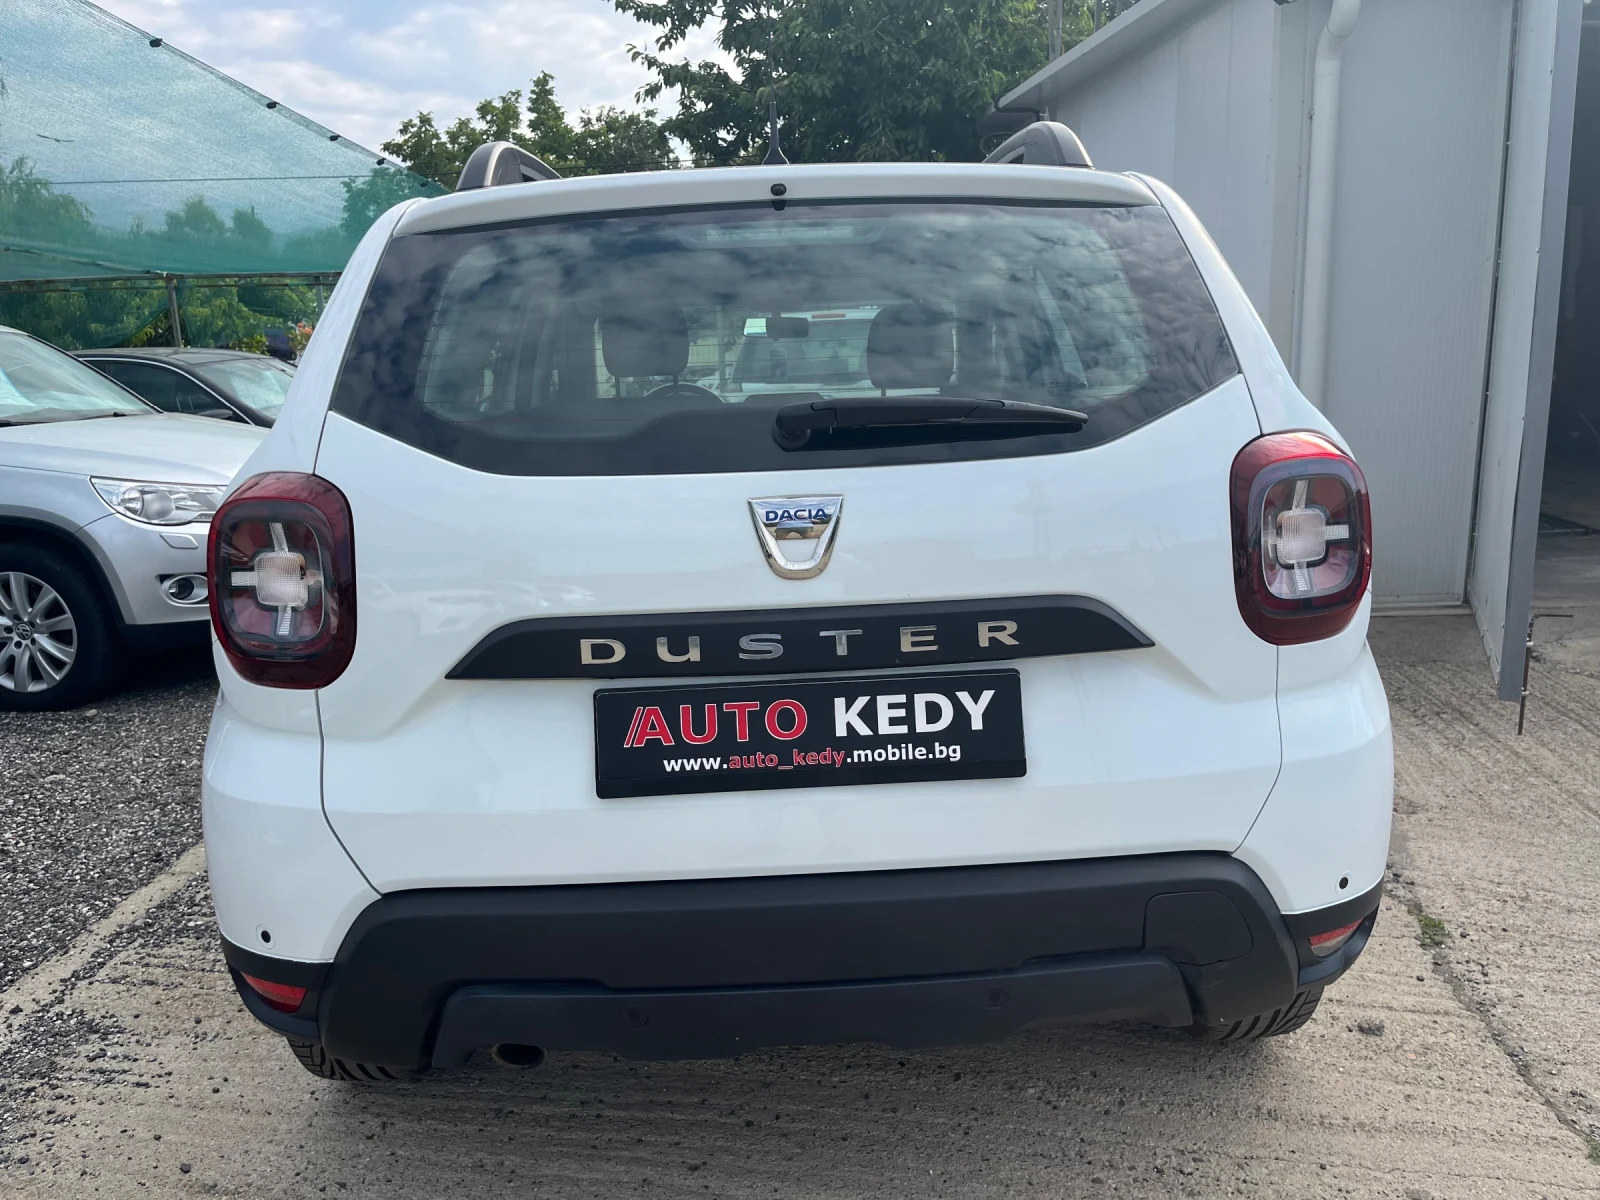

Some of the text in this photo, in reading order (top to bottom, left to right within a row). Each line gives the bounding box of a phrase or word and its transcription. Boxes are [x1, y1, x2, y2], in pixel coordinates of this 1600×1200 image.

[765, 508, 828, 522] DACIA
[580, 620, 1020, 665] DUSTER
[833, 689, 996, 737] KEDY
[663, 742, 962, 772] www.auto_kedy.mobile.bg
